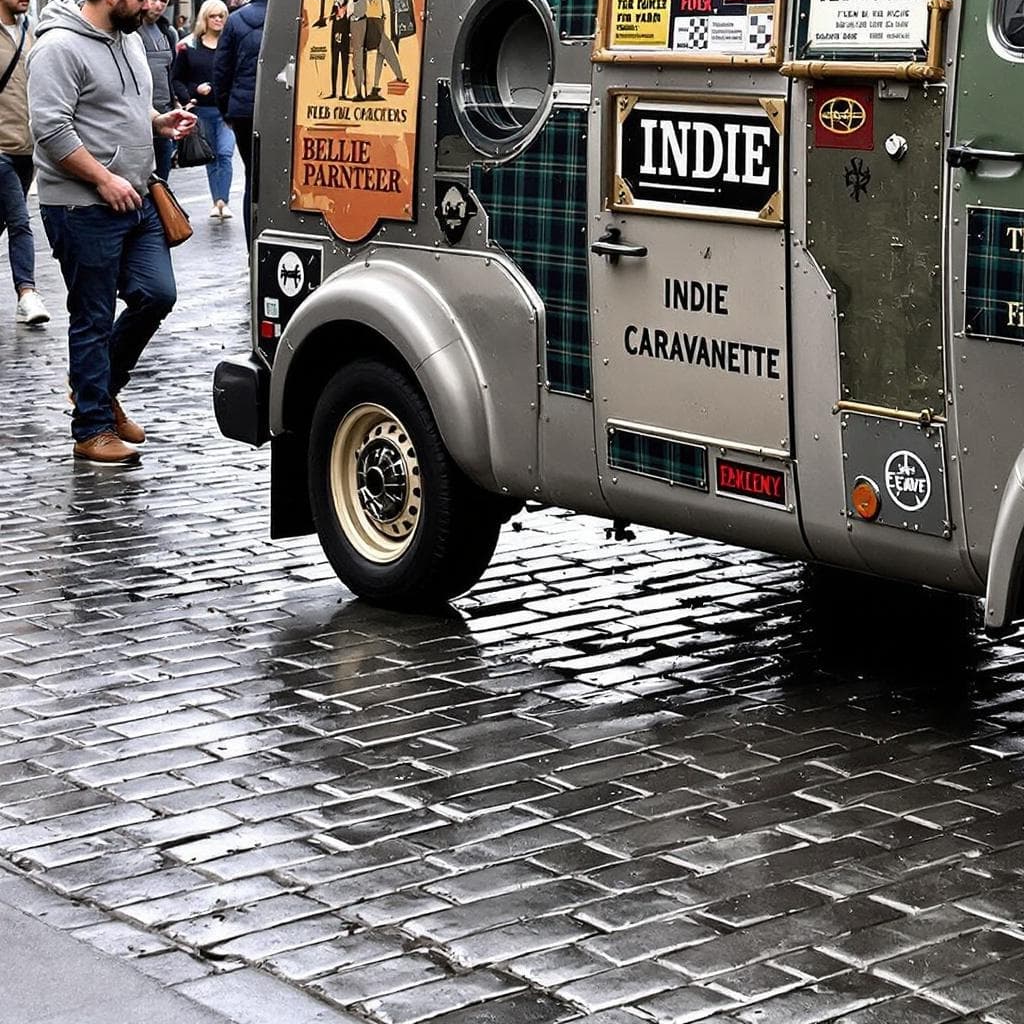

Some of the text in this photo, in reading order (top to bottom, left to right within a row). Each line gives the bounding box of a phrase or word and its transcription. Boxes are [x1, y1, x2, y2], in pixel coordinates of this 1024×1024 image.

[302, 137, 372, 165] BELLIE
[638, 118, 772, 186] INDIE
[303, 163, 402, 194] PARNTEER
[663, 277, 729, 316] INDIE
[623, 324, 780, 380] CARAVANETTE
